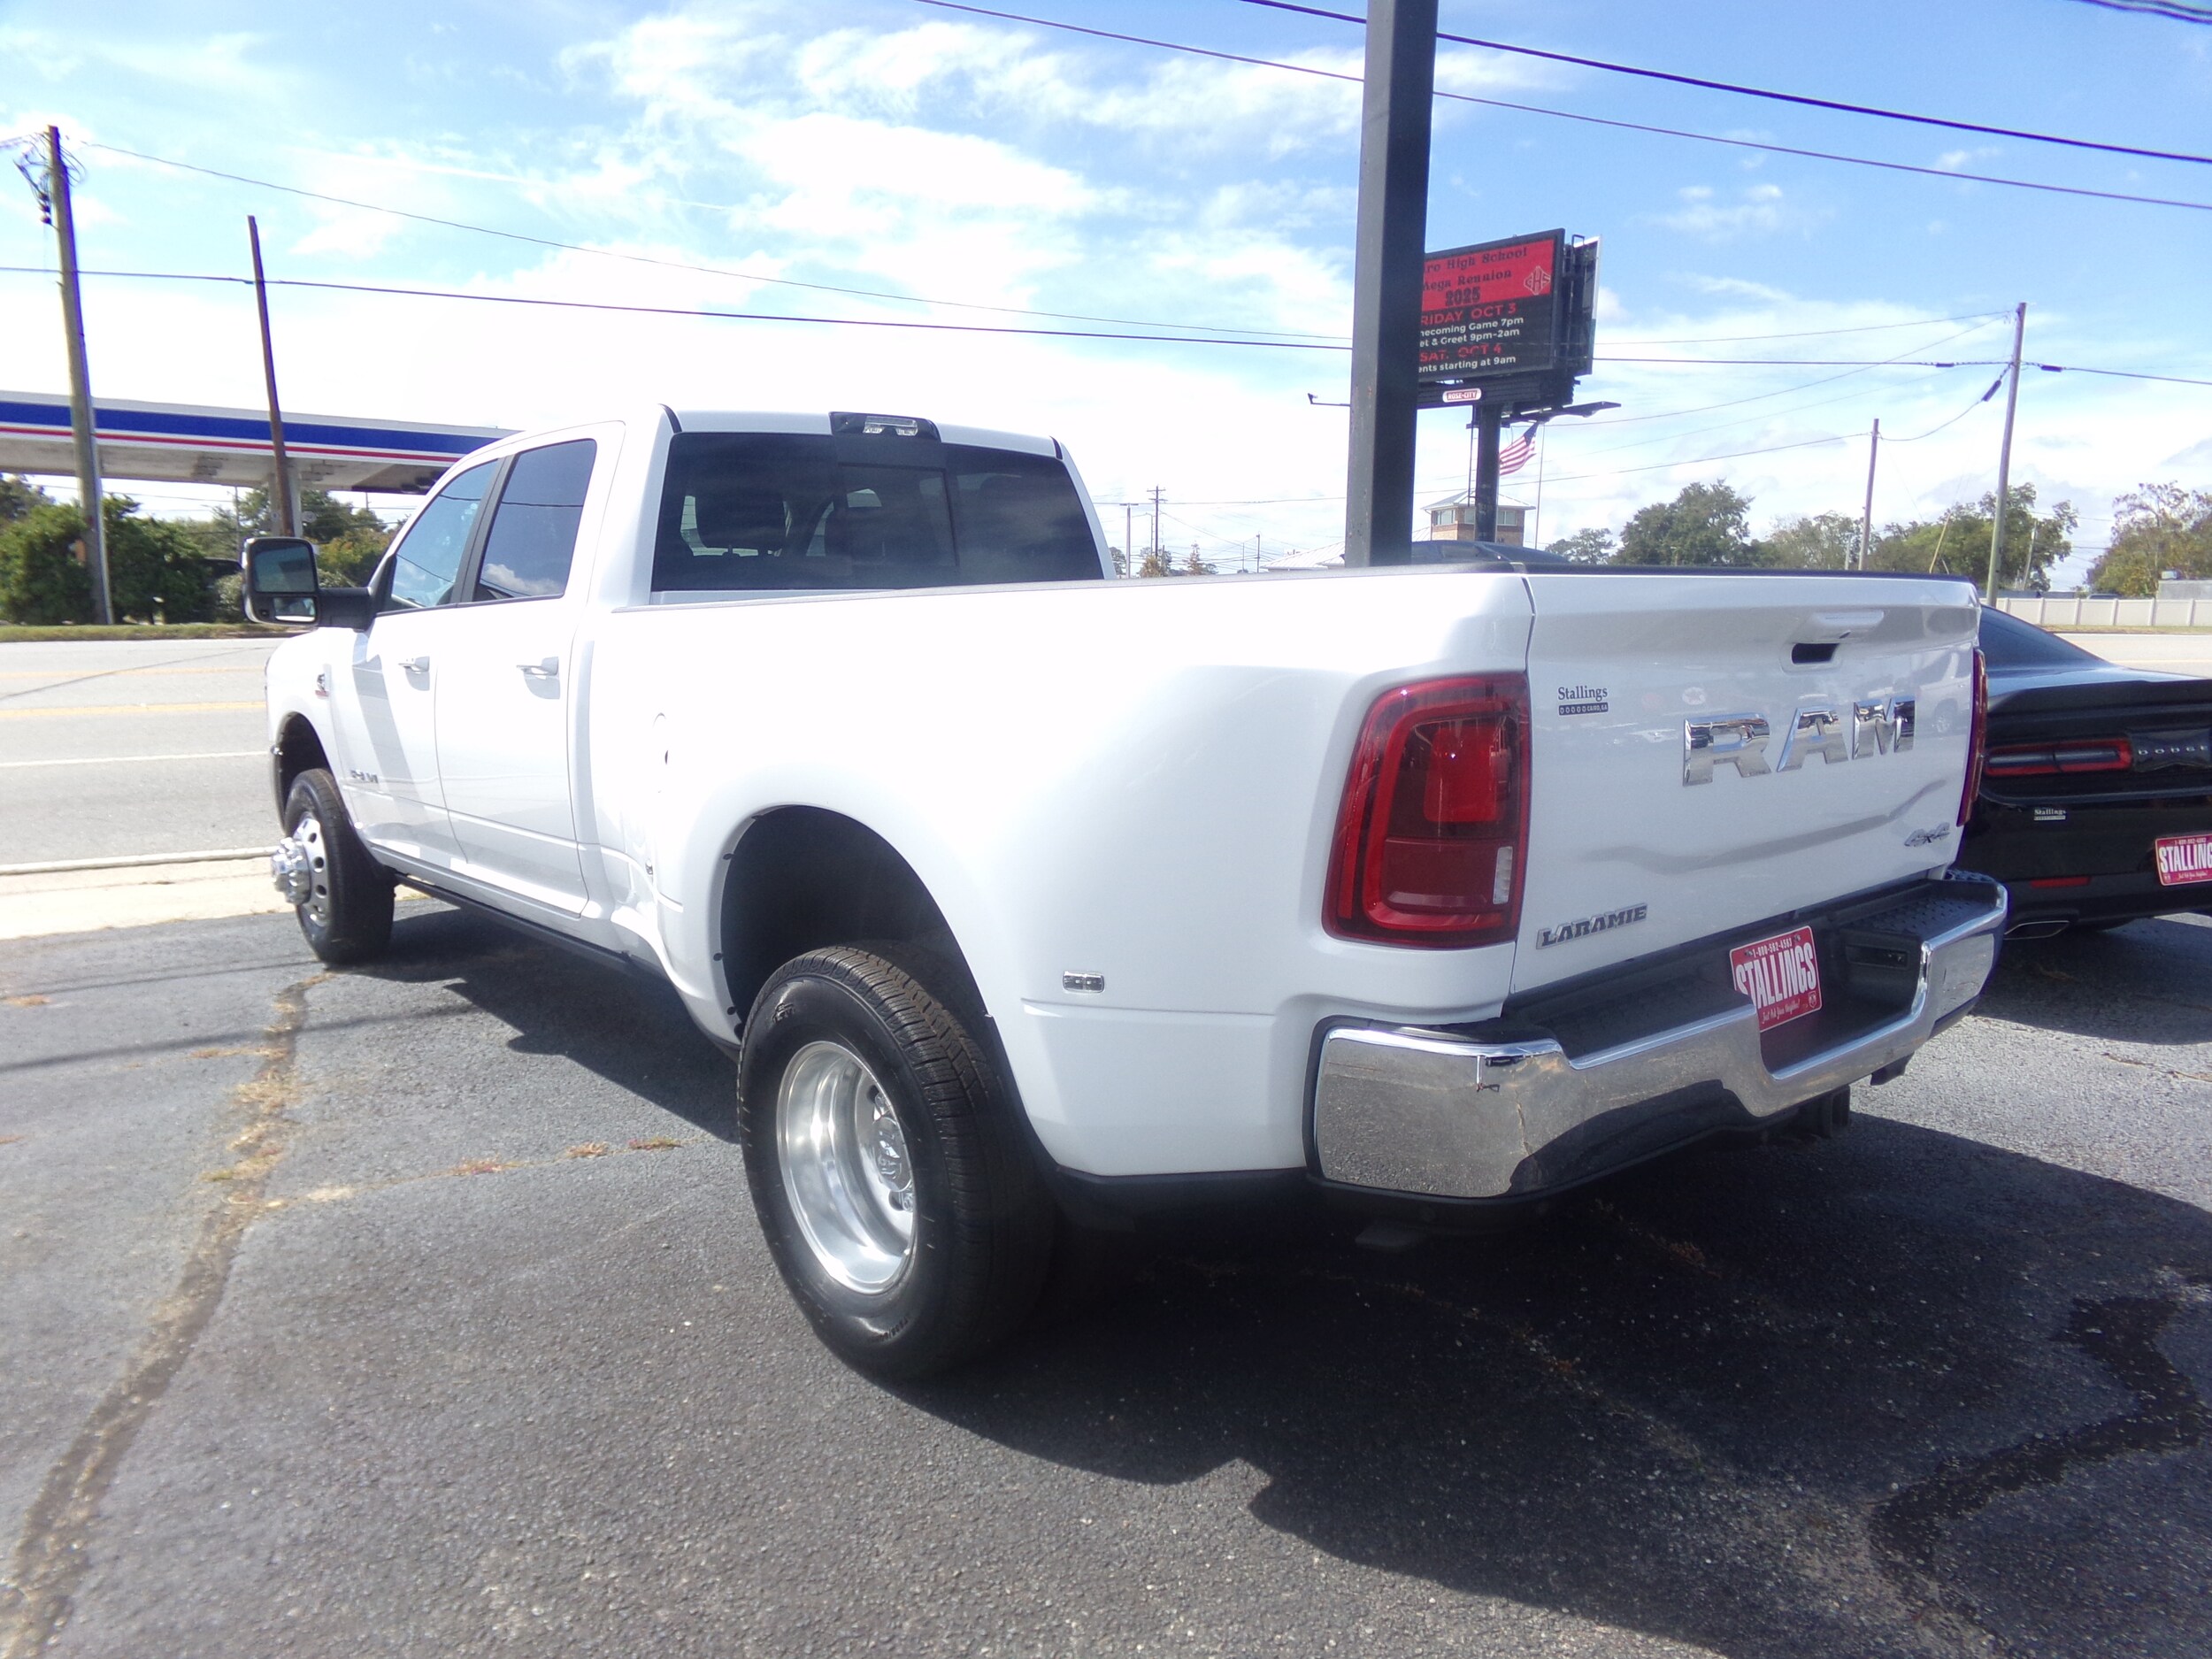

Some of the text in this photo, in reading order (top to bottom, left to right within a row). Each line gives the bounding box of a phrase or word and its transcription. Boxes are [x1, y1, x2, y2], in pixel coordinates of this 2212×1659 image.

[1447, 255, 1476, 271] High
[1481, 247, 1528, 264] School
[1445, 286, 1481, 307] 2025
[1471, 304, 1504, 319] OCT
[1508, 302, 1517, 315] 3
[1469, 320, 1499, 332] Game
[1501, 317, 1525, 327] 7pm
[1432, 337, 1439, 346] &
[1440, 334, 1468, 345] Greet
[1470, 328, 1520, 342] 9pm-2am
[1457, 342, 1490, 359] OCT
[1440, 359, 1479, 371] starting
[1480, 357, 1492, 367] at
[1494, 356, 1517, 365] 9am
[1558, 685, 1609, 702] Stallings
[1683, 695, 1916, 787] RAM
[1539, 903, 1648, 948] LARAMIE
[1736, 942, 1816, 1009] STALLINGS
